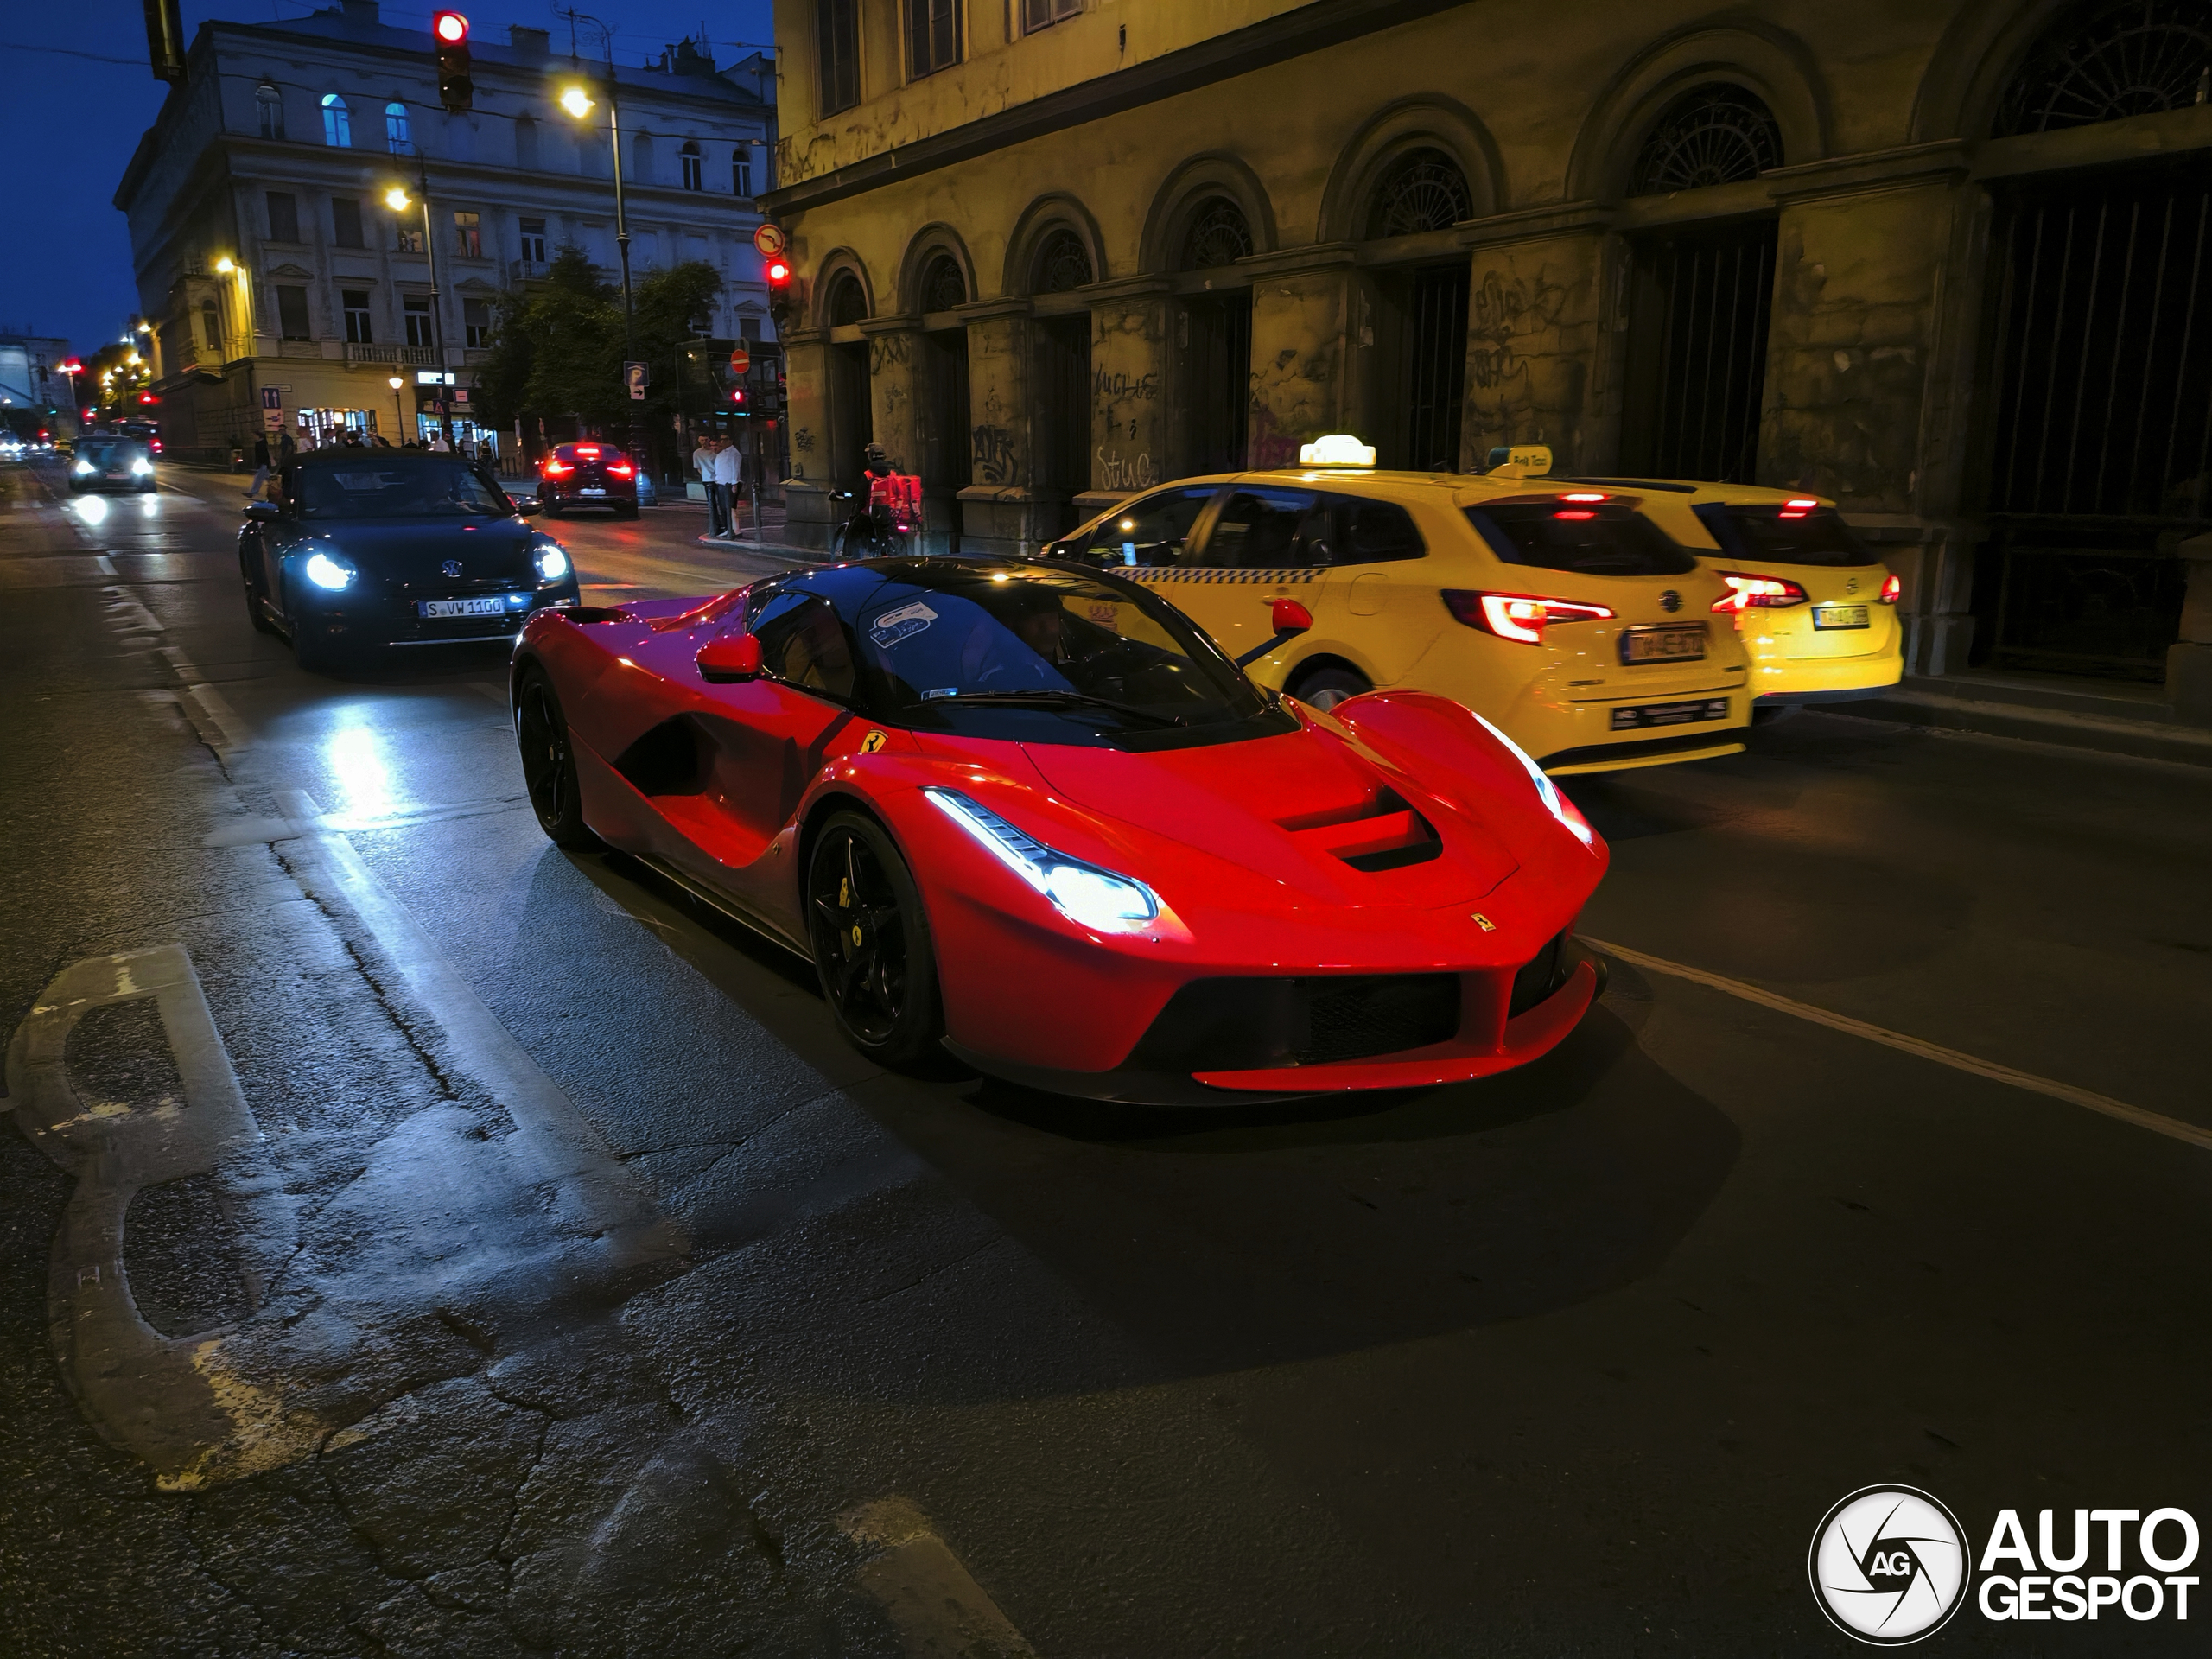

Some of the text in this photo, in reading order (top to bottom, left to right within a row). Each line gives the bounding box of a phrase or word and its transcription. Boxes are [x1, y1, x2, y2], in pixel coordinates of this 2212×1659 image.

[429, 600, 501, 616] S VW 1100
